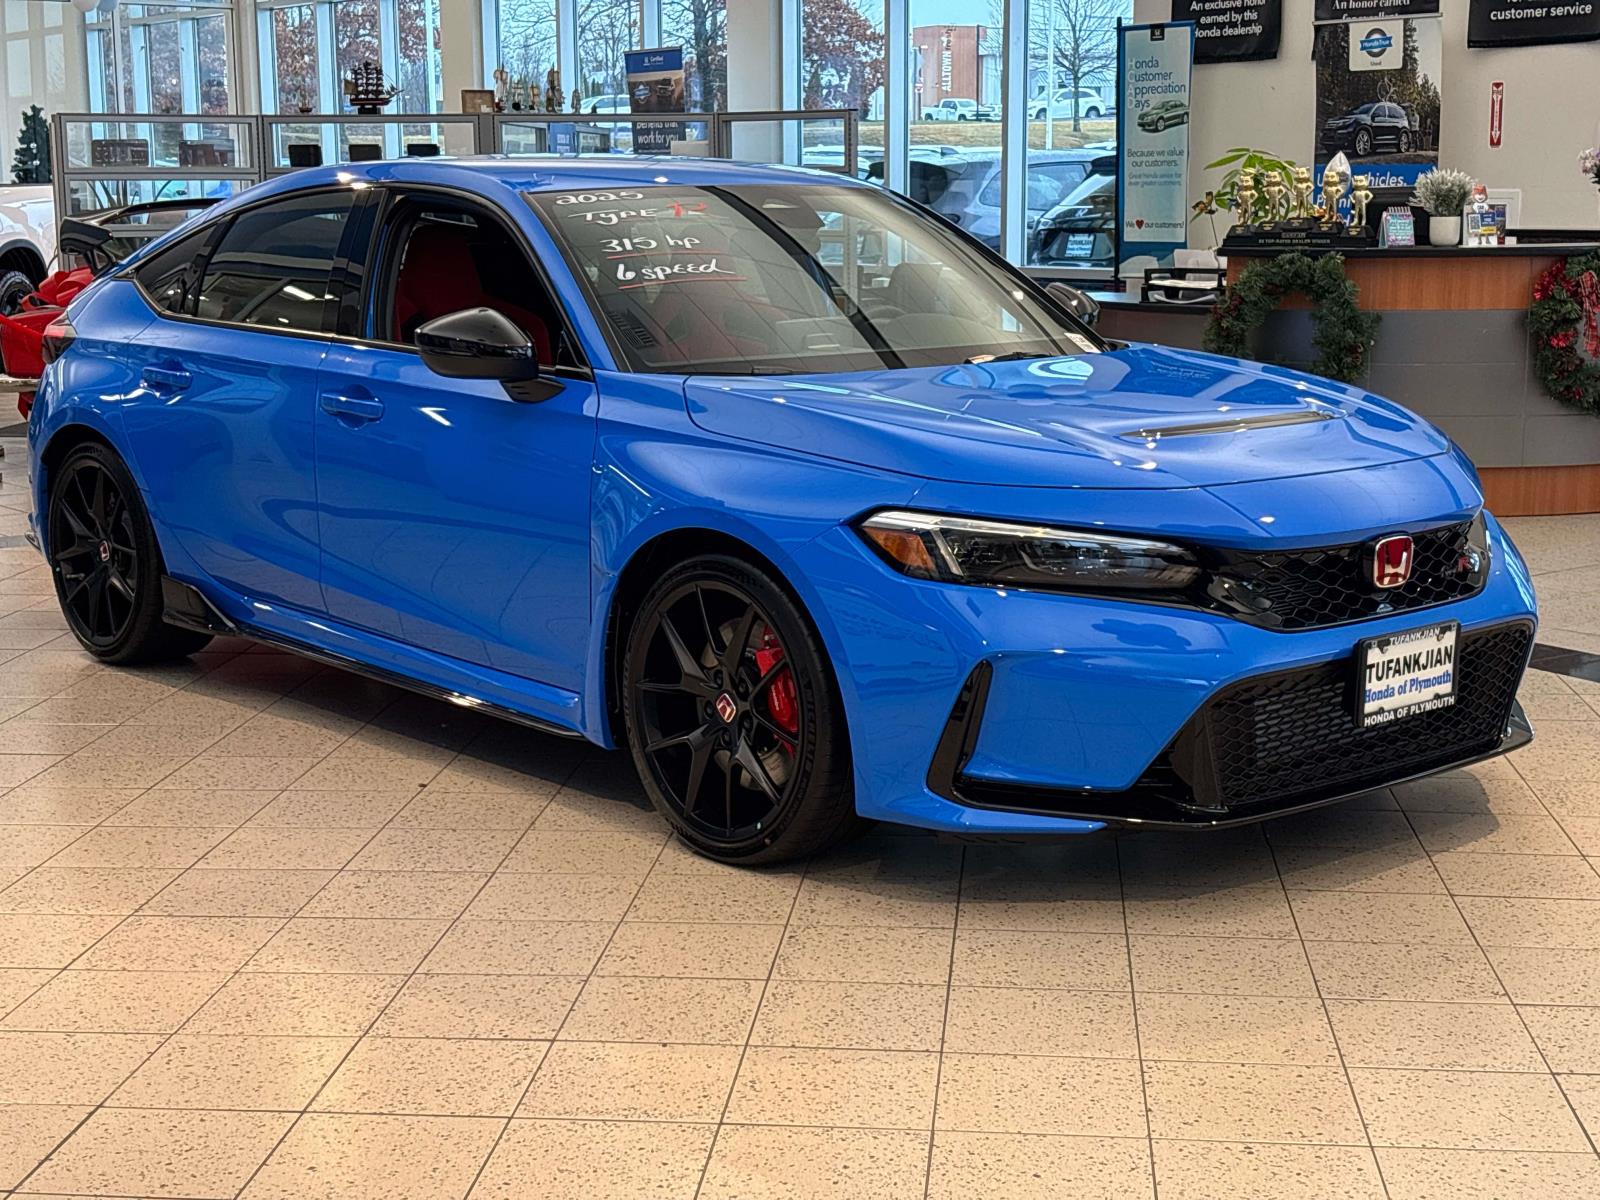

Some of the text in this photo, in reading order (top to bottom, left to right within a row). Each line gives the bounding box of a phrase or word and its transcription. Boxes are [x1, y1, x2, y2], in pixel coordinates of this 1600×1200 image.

[1190, 1, 1203, 11] An
[1204, 0, 1242, 10] exclusive
[1332, 0, 1347, 10] An
[1348, 0, 1378, 9] honor
[1490, 2, 1592, 20] customer service
[1200, 10, 1258, 24] earned by this
[1222, 24, 1262, 36] dealership
[941, 50, 952, 92] ALLTOWN
[1128, 82, 1186, 98] Appreciation
[638, 131, 678, 146] work for you
[1127, 148, 1154, 158] Because
[1166, 147, 1184, 157] value
[555, 191, 644, 205] 2025
[600, 234, 701, 253] 315 hp
[616, 263, 636, 281] 6
[1389, 628, 1441, 646] TUFANKJIAN
[1366, 644, 1454, 684] TUFANKJIAN
[1364, 670, 1452, 704] Honda of Plymouth
[1364, 696, 1455, 727] HONDA OF PLYMOUTH
